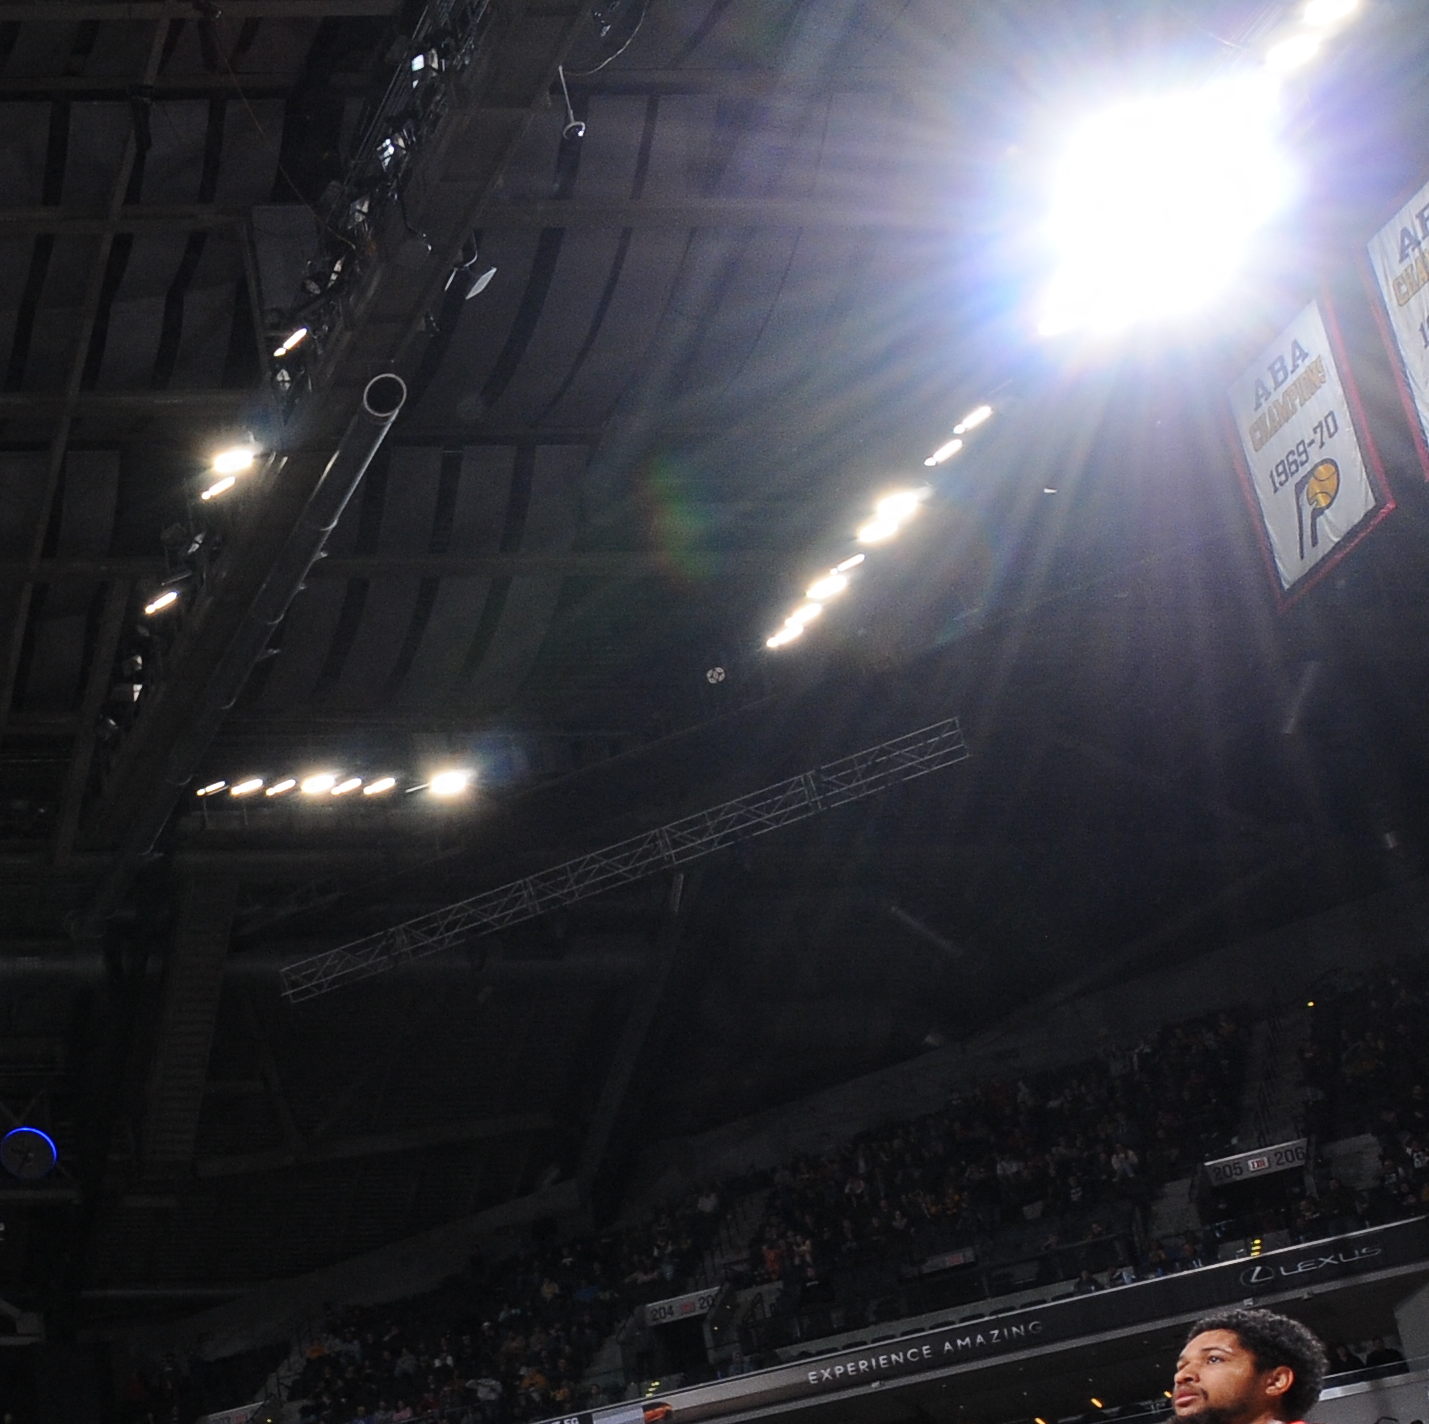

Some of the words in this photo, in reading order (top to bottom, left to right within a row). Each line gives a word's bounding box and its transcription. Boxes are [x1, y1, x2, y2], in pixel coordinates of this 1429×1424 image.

[1253, 338, 1310, 411] ABA
[1269, 411, 1339, 495] 1969-70
[1277, 1243, 1382, 1278] LEXUS
[651, 1305, 674, 1321] 204
[808, 1344, 933, 1385] EXPERIENCE
[941, 1321, 1043, 1354] AMAZING
